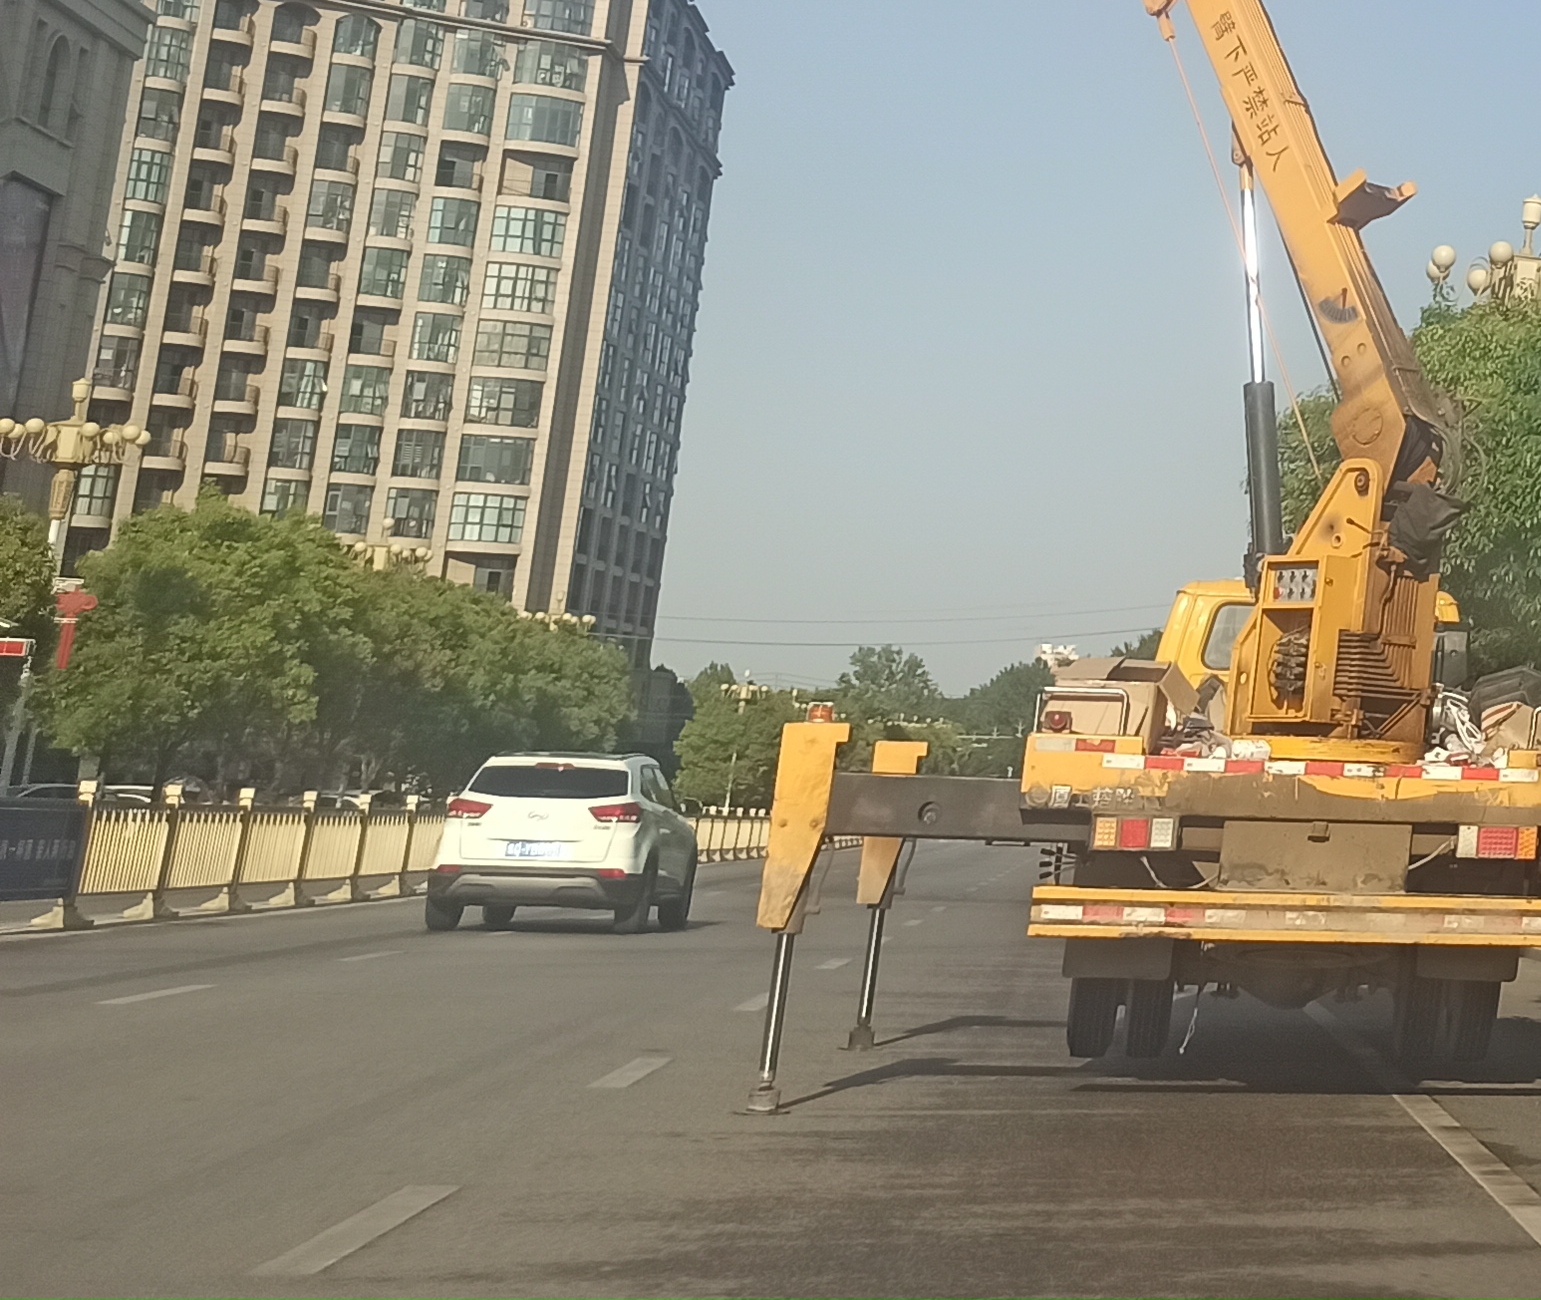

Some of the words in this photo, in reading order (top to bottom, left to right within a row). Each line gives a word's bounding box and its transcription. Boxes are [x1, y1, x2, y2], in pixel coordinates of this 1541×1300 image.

[1211, 10, 1289, 172] 臂下严禁站人
